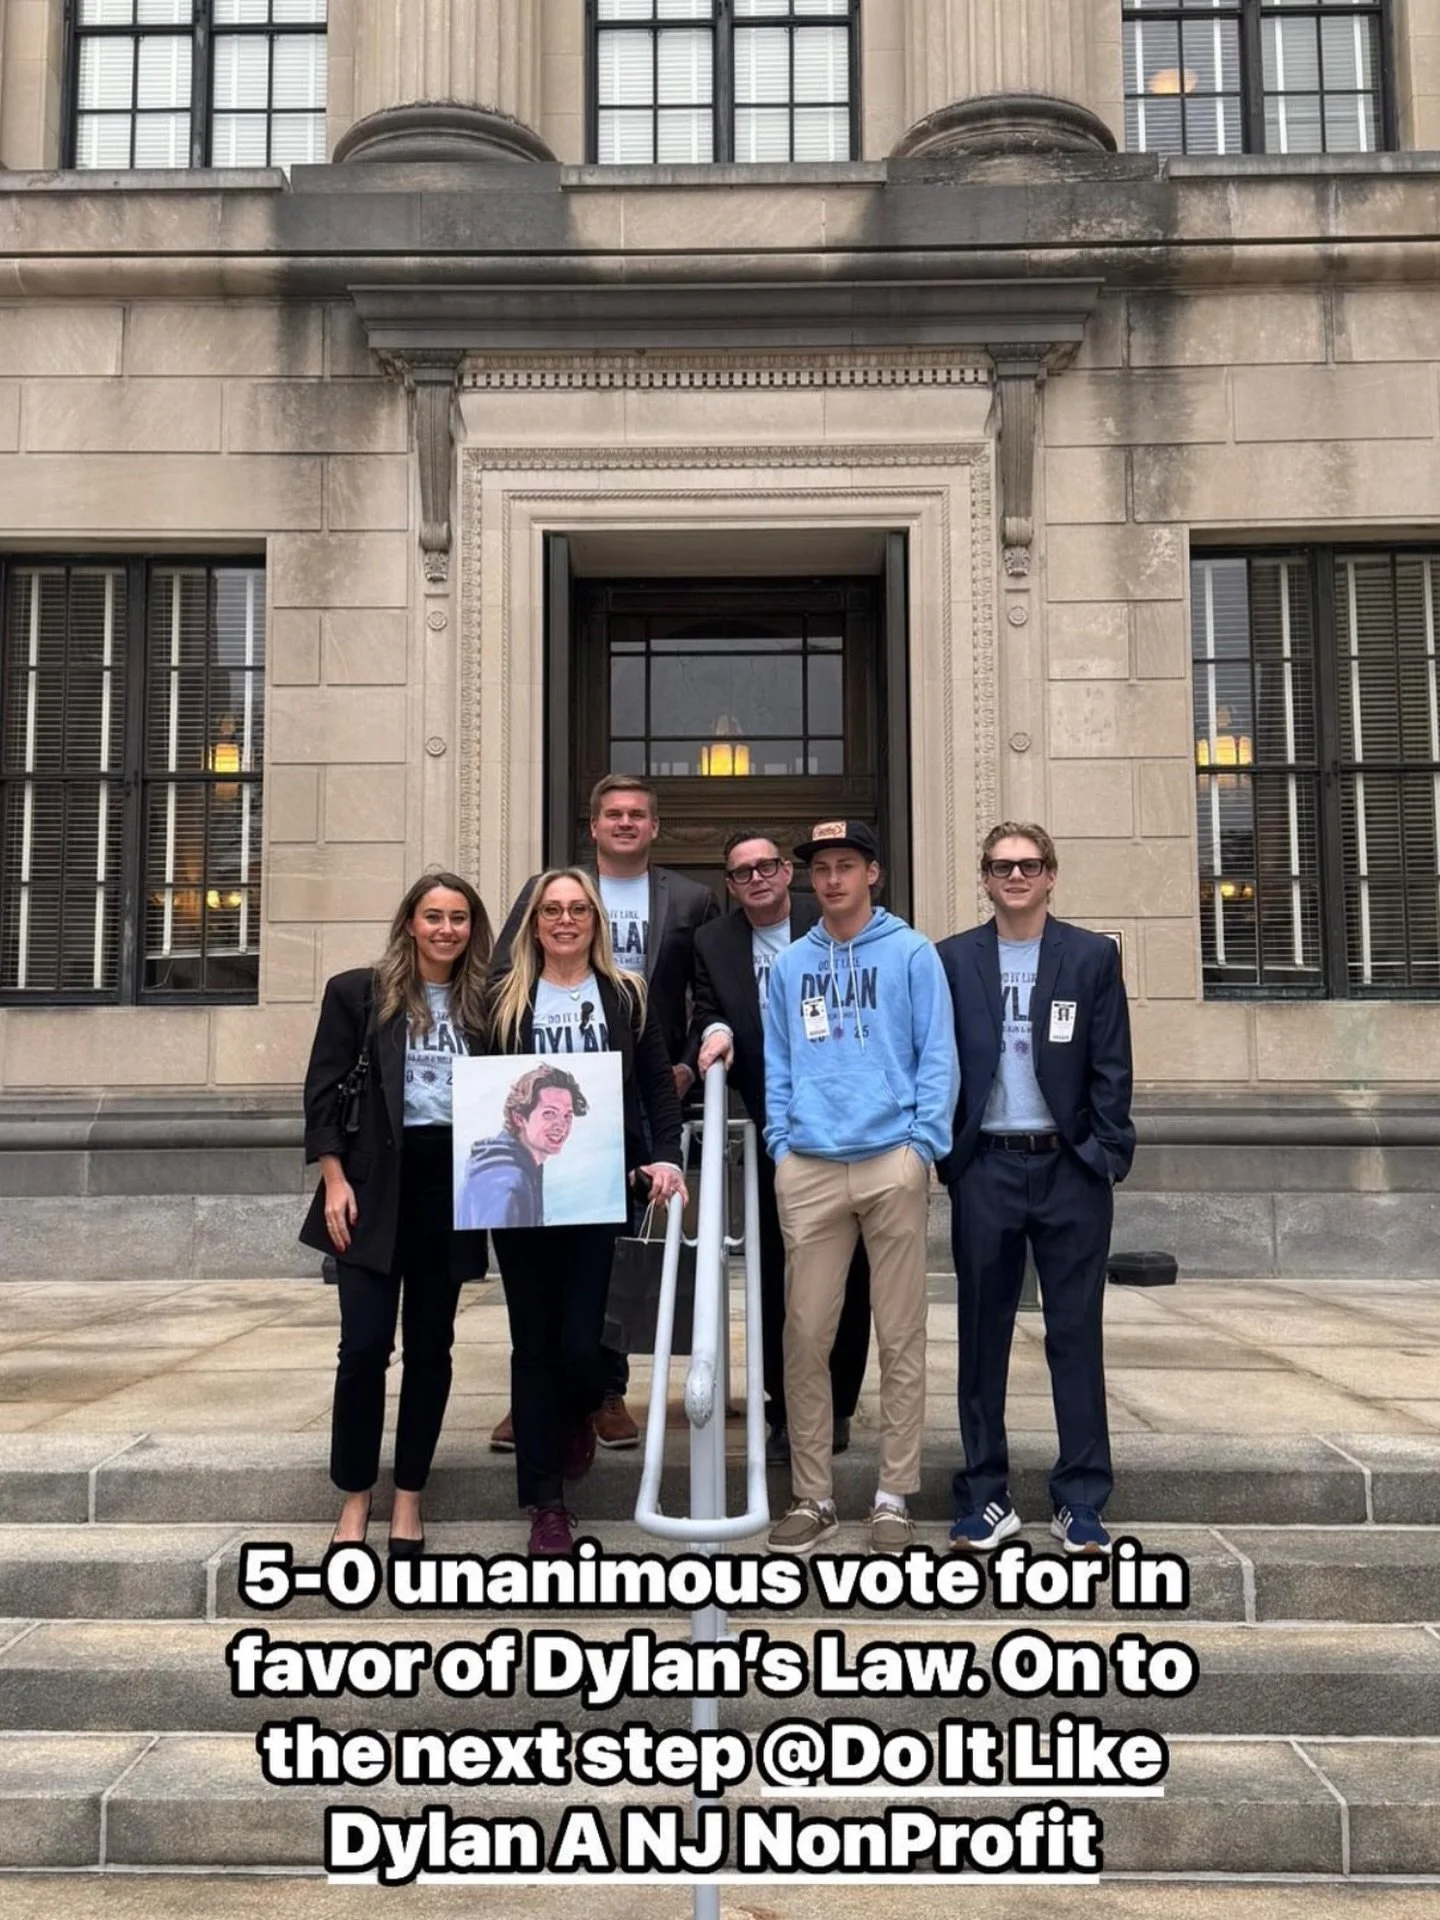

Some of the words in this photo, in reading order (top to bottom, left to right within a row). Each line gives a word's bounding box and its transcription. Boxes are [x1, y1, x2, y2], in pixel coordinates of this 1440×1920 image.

[800, 965, 878, 1018] DYLAN
[547, 1013, 561, 1024] DO
[562, 1012, 573, 1023] IT
[854, 1025, 870, 1039] 25
